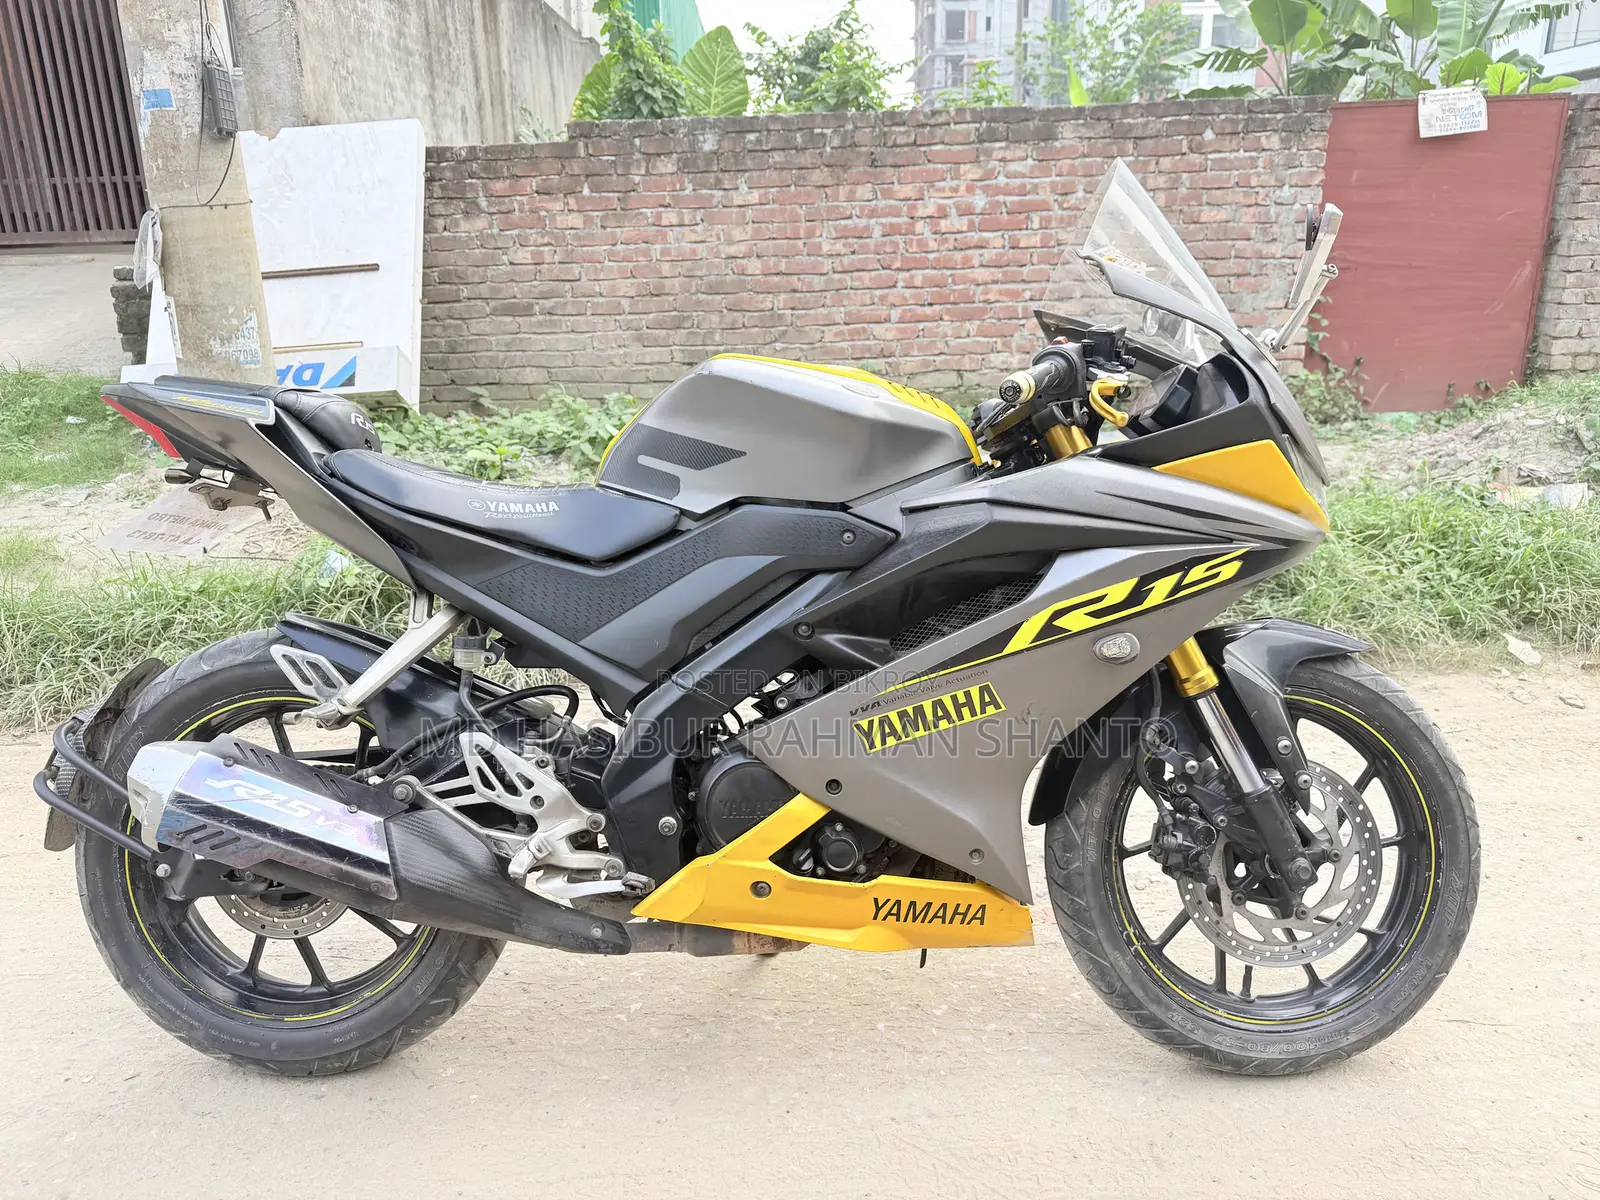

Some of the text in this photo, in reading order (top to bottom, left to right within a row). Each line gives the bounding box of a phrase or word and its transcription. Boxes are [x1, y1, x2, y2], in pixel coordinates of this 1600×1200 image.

[1435, 111, 1483, 123] NETCOM
[486, 500, 559, 512] YAMAHA
[1003, 548, 1251, 655] R15
[882, 690, 920, 705] Variable
[919, 681, 945, 694] Valve
[944, 668, 990, 686] Actuation
[854, 684, 1004, 750] YAMAHA
[872, 897, 987, 926] YAMAHA
